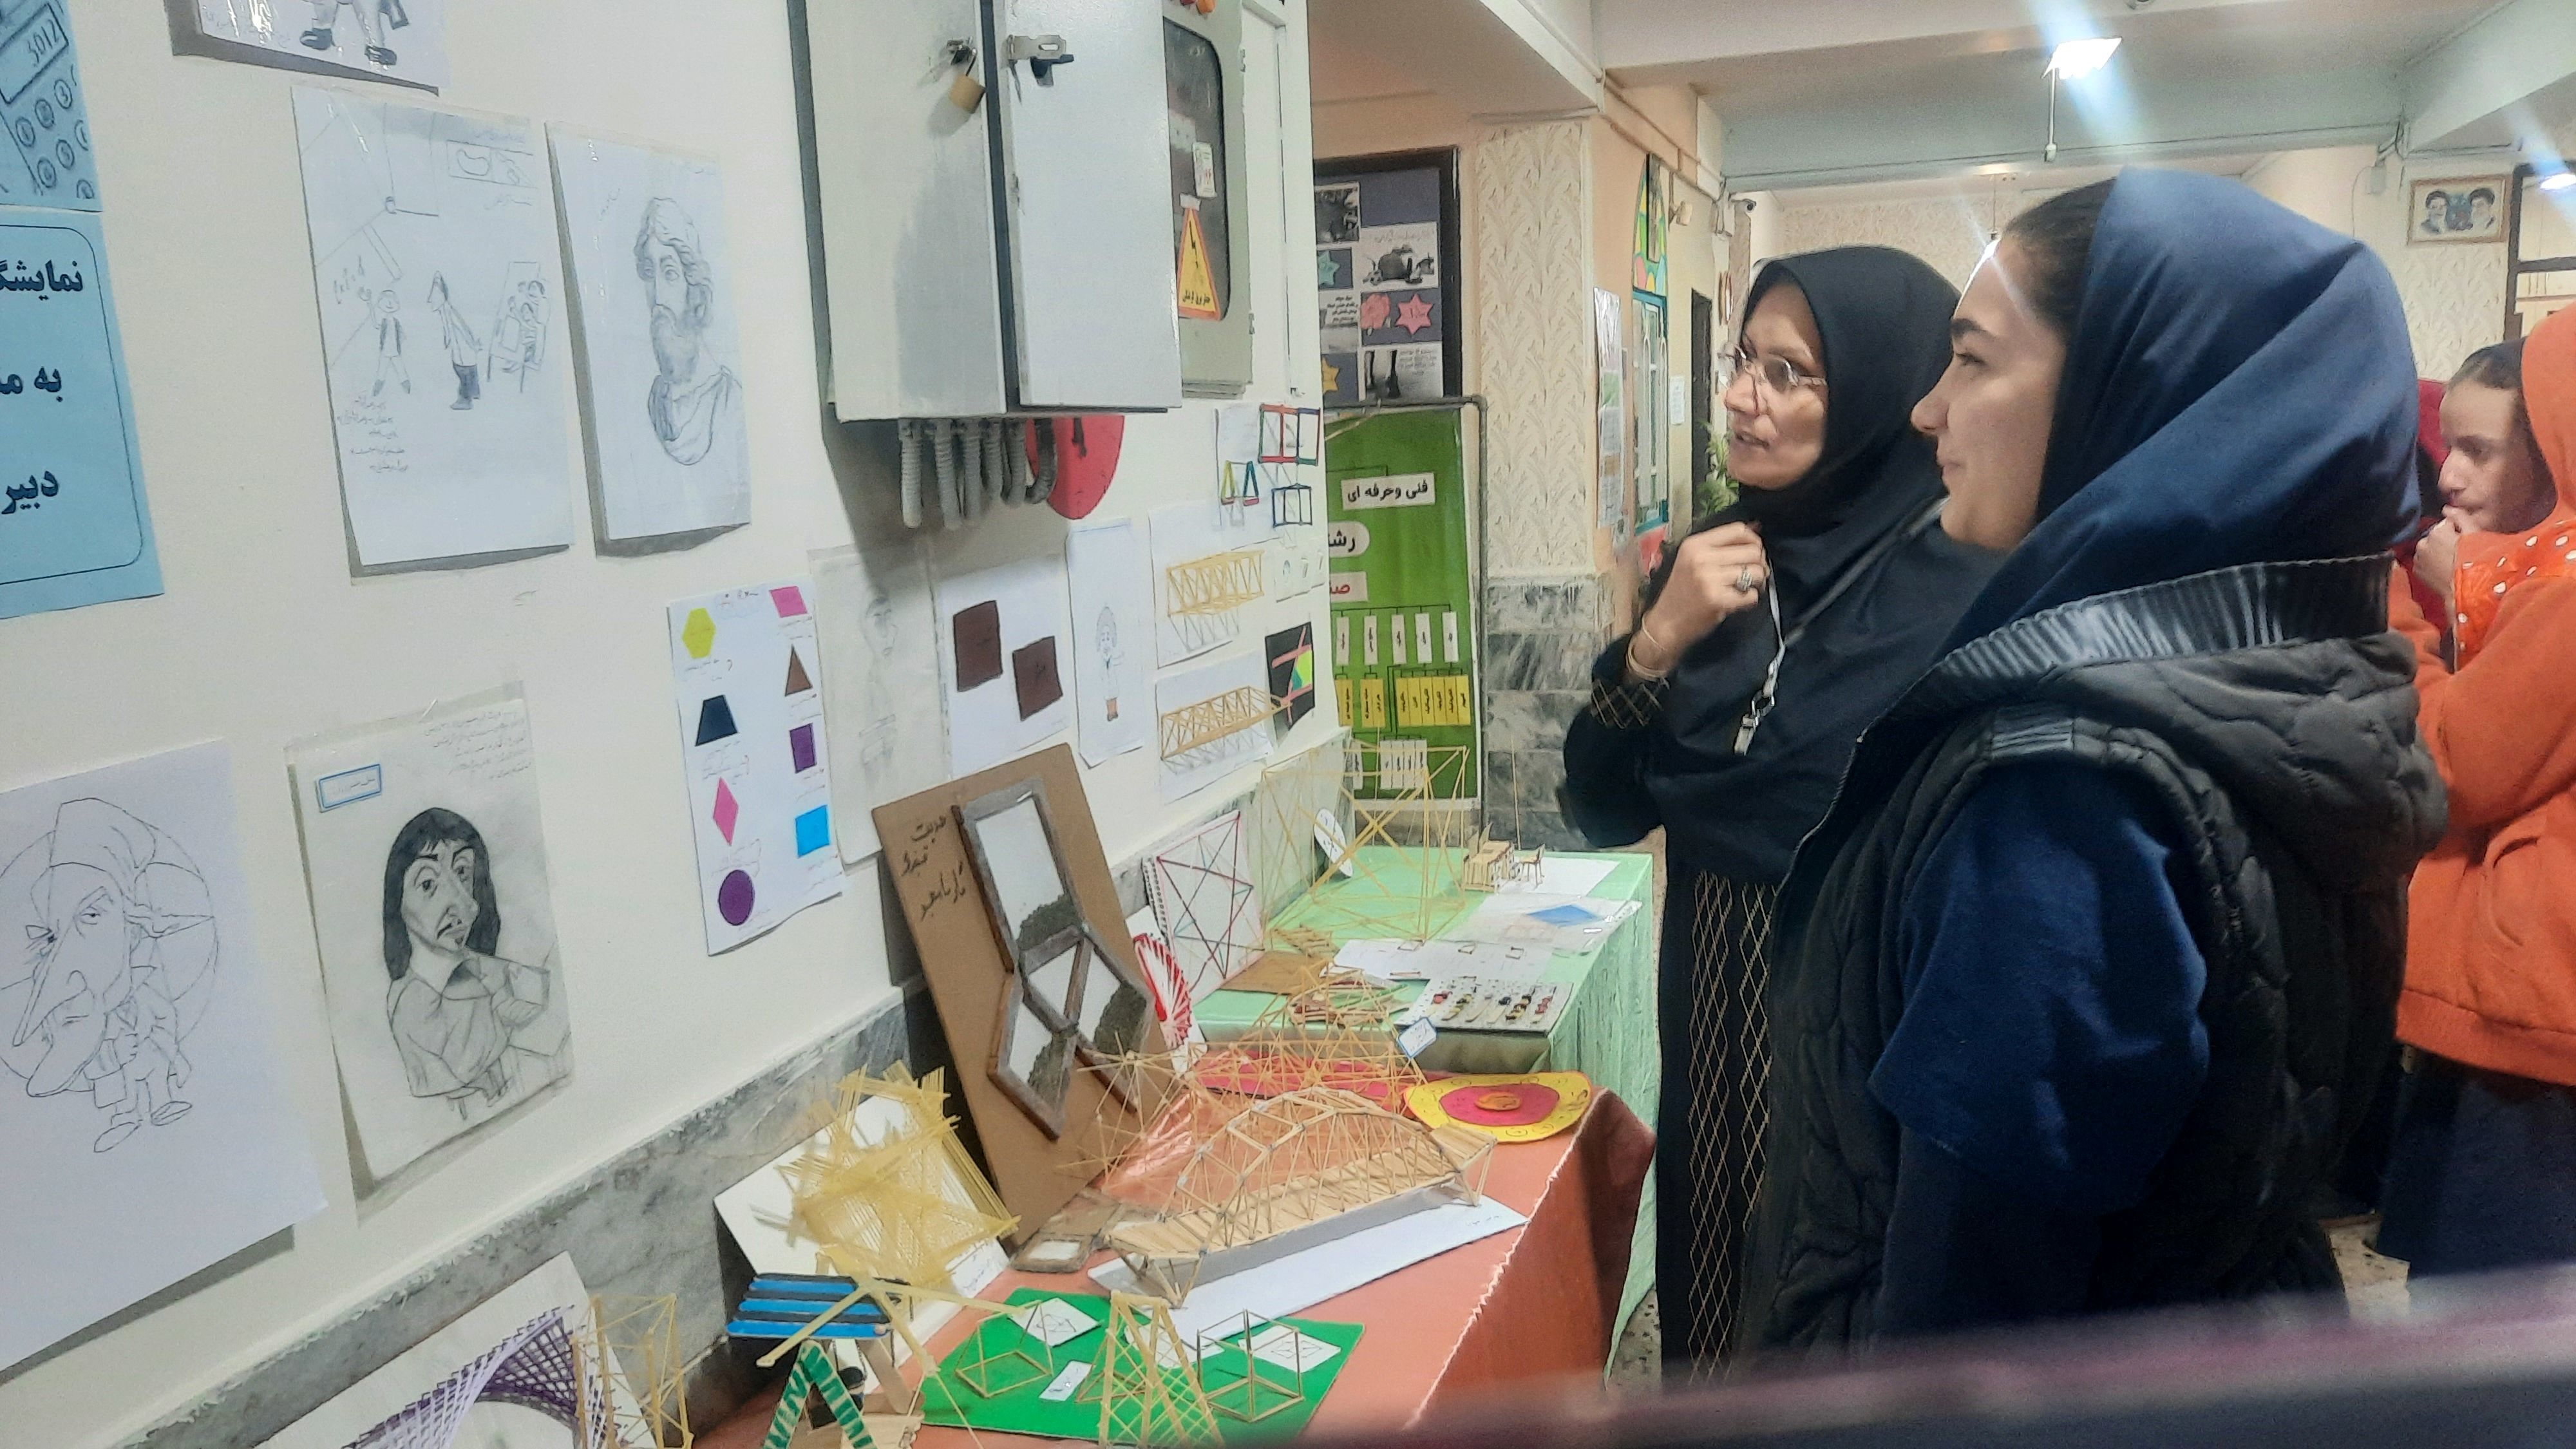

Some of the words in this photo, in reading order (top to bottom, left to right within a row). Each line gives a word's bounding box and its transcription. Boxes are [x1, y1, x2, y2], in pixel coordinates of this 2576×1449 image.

[33, 366, 63, 402] به
[1, 470, 59, 515] دبیر
[1405, 479, 1428, 500] فنی
